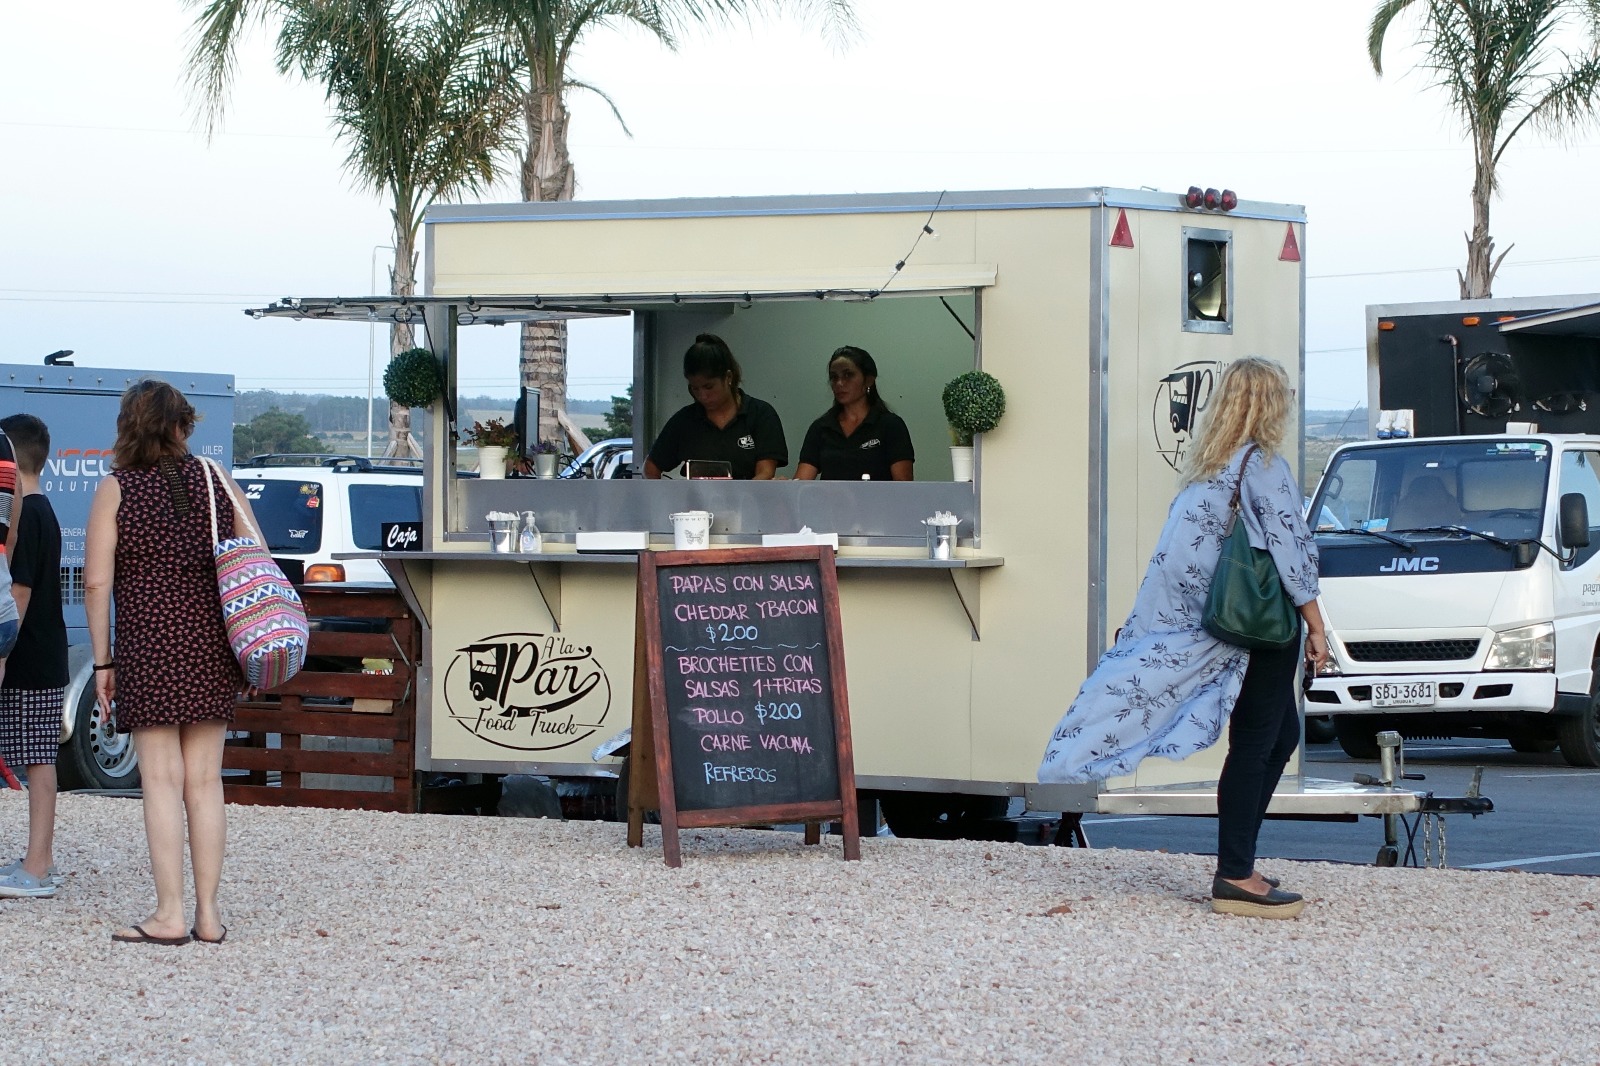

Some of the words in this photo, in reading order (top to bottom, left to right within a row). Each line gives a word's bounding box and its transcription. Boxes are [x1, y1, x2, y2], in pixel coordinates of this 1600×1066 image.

[202, 445, 224, 455] UILER
[45, 480, 98, 492] OLUTI
[387, 524, 418, 549] Caja
[1380, 556, 1440, 572] JMC
[669, 575, 727, 595] PAPAS
[733, 575, 764, 592] CON
[769, 574, 814, 592] SALSA
[674, 603, 750, 622] CHEDDAR
[705, 623, 759, 644] $200
[499, 641, 601, 709] Par
[678, 655, 777, 675] BROCHETTES
[783, 654, 814, 674] CON
[685, 679, 740, 699] SALSAS
[1403, 684, 1432, 699] 3681
[474, 705, 517, 735] Food
[530, 709, 578, 737] Truck
[692, 707, 744, 725] POLLO
[754, 700, 802, 726] $200
[700, 734, 752, 752] CARNE
[703, 762, 777, 785] REFRESCOS
